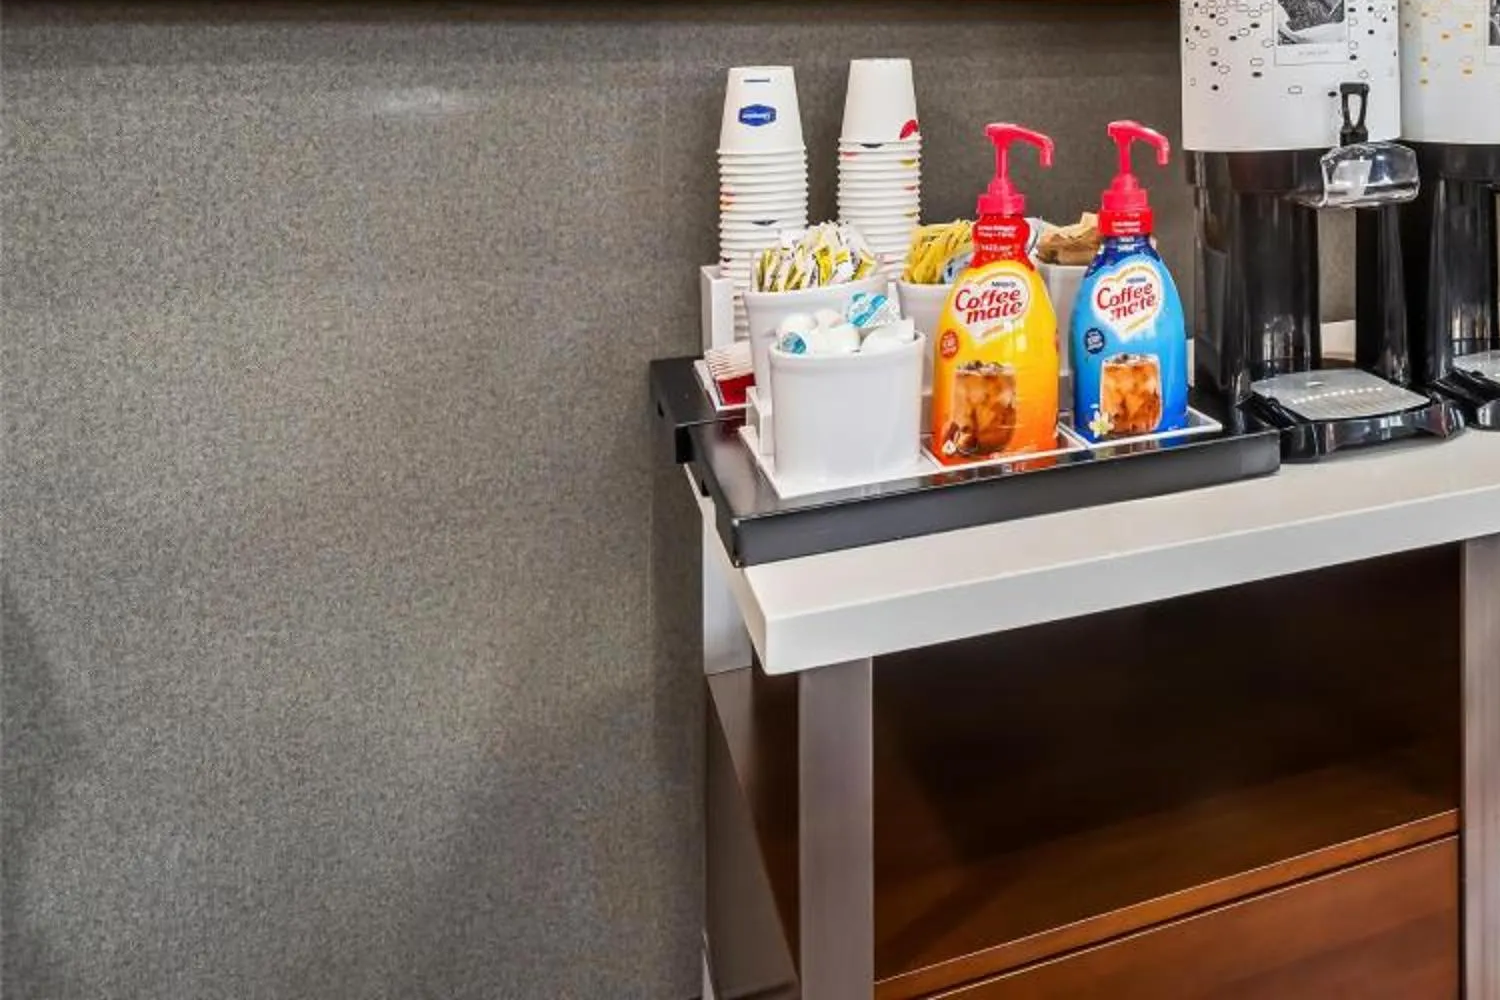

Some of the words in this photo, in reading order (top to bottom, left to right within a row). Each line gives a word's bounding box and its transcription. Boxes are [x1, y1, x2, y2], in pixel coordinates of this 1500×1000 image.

[955, 289, 1021, 312] Coffee
[1097, 283, 1153, 310] Coffee
[966, 301, 1022, 324] mate
